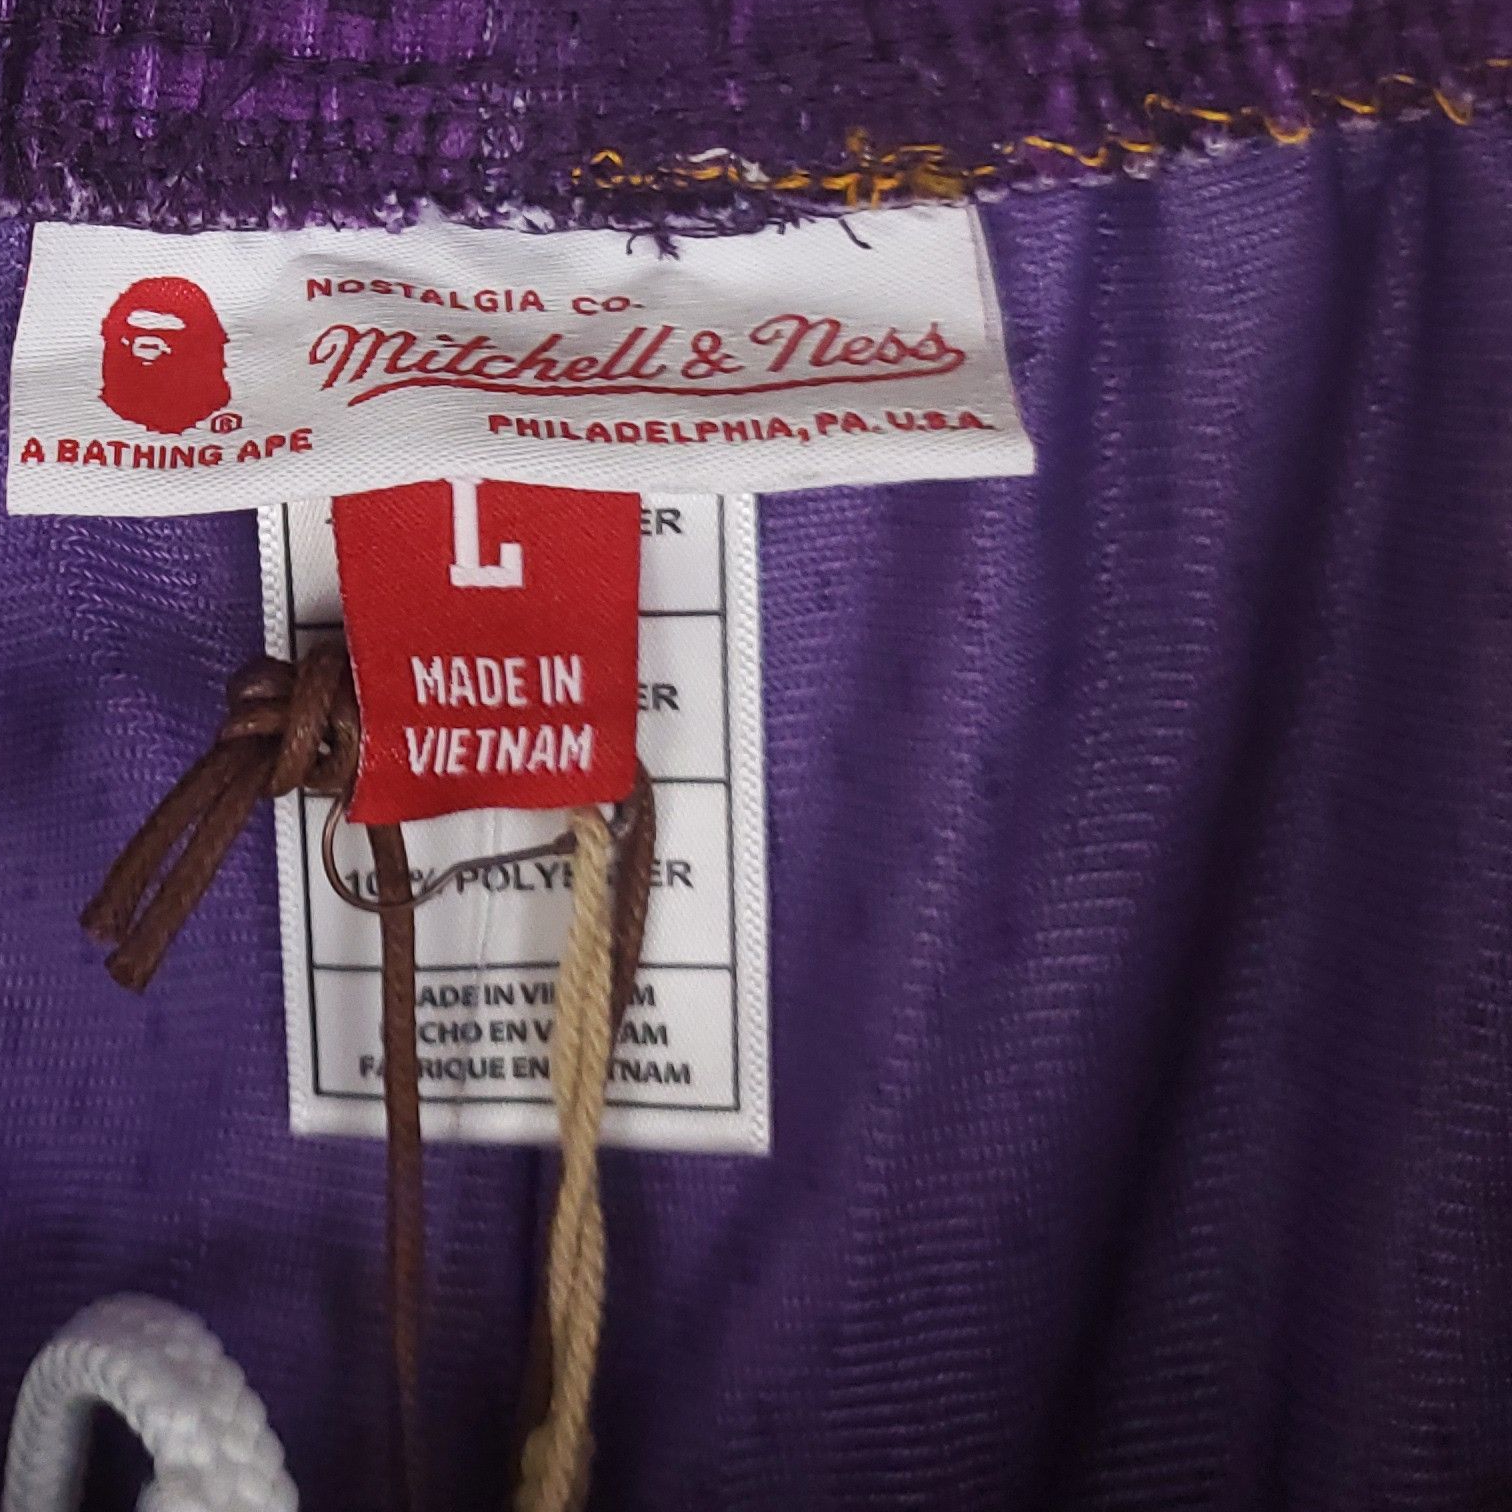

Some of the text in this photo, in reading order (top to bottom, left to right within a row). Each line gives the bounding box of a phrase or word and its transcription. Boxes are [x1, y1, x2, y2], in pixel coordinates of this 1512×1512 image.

[306, 277, 545, 314] NOSTALGIA
[308, 313, 966, 391] Mitchell & Ness
[20, 427, 314, 470] A BATHING APE
[487, 413, 811, 445] PHILADELPHIA,
[442, 478, 525, 589] L
[409, 655, 529, 707] MADE
[539, 654, 583, 706] IN
[403, 724, 594, 776] VIETNAM
[414, 984, 480, 1008] ADE
[483, 982, 515, 1006] IN
[489, 1019, 528, 1043] EN
[358, 1053, 506, 1086] FRIQUE
[512, 1054, 551, 1080] EN
